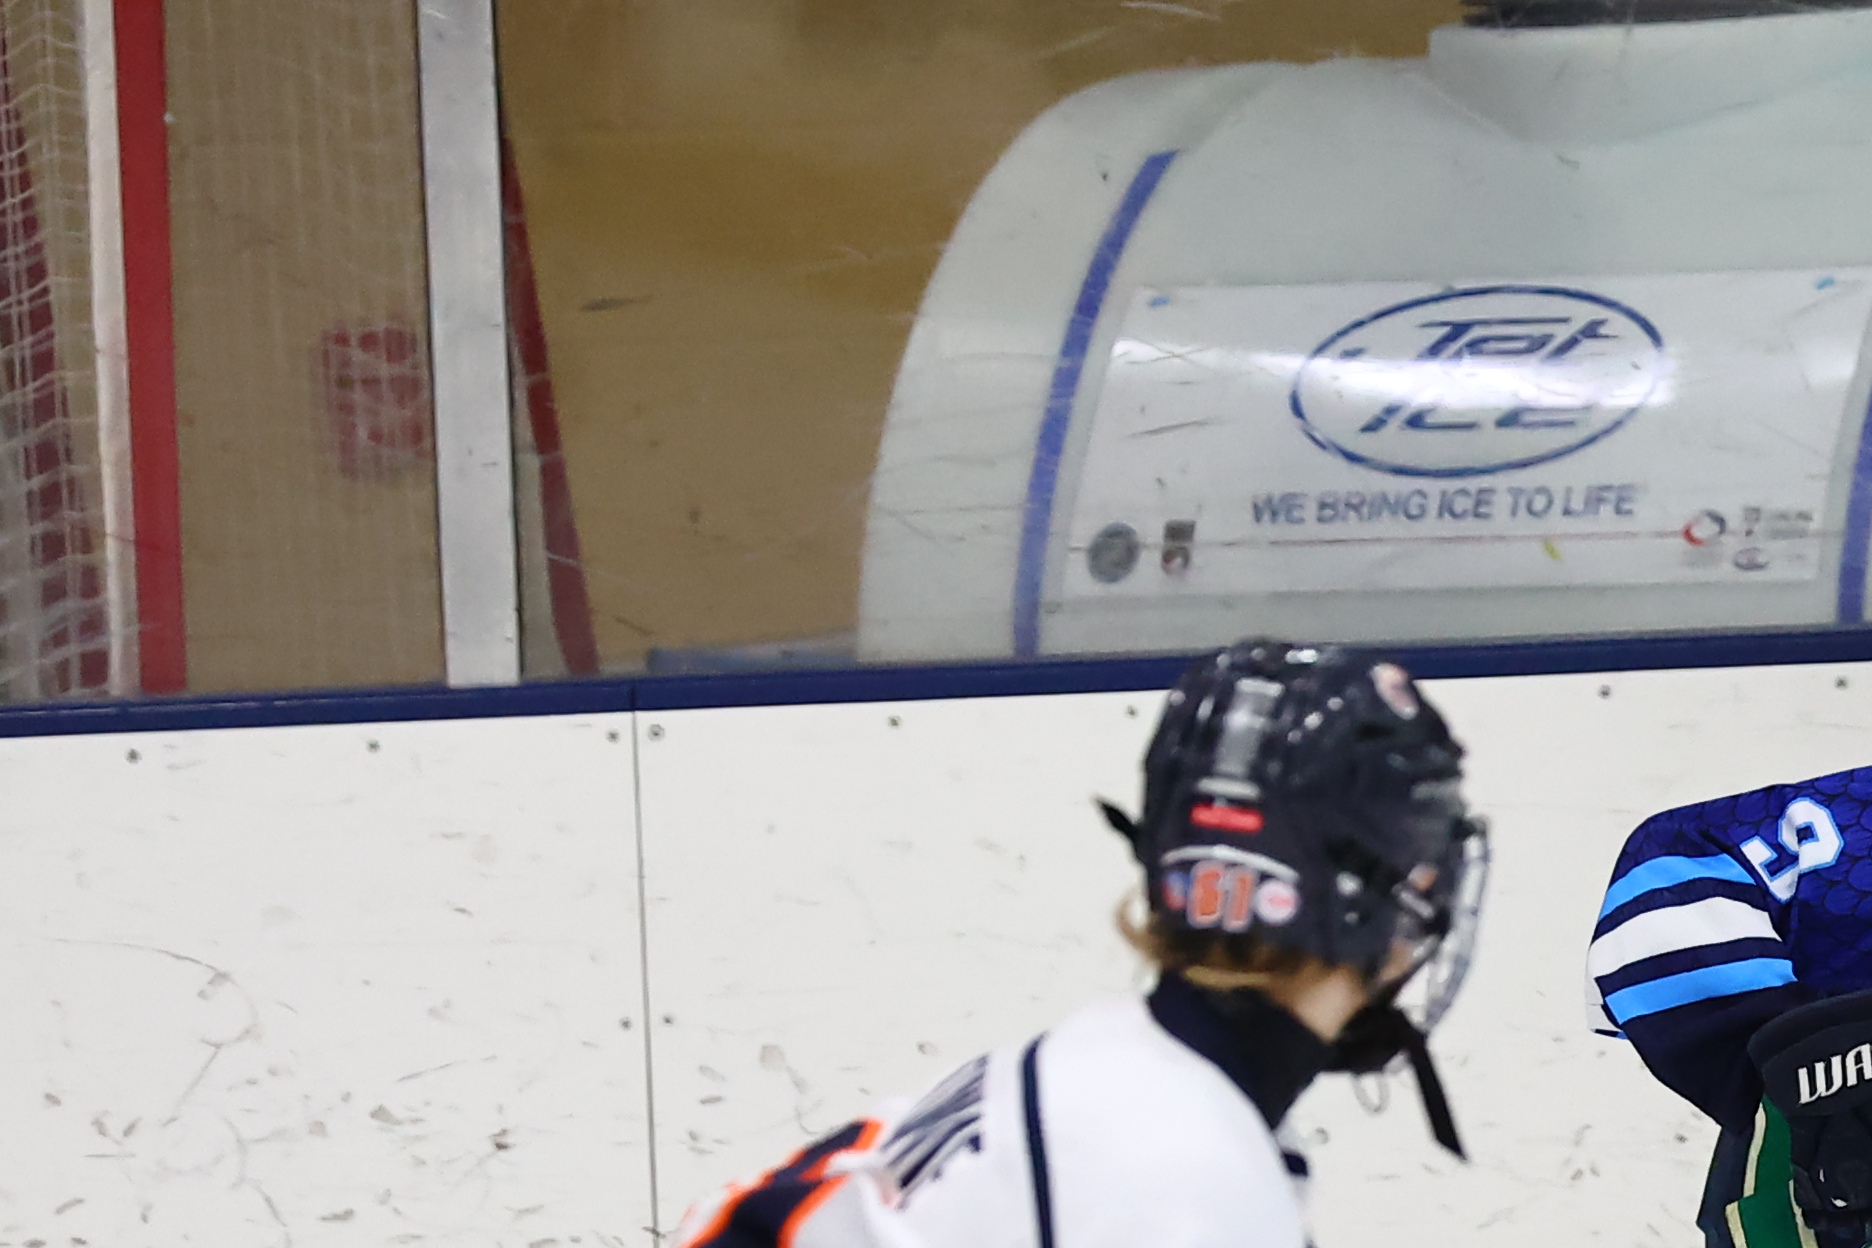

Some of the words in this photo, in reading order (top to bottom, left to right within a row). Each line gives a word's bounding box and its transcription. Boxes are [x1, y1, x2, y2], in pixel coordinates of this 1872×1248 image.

[1250, 493, 1306, 525] WE
[1315, 489, 1428, 523] BRING
[1436, 486, 1496, 521] ICE
[1508, 485, 1554, 518] TO
[1562, 483, 1640, 517] LIFE
